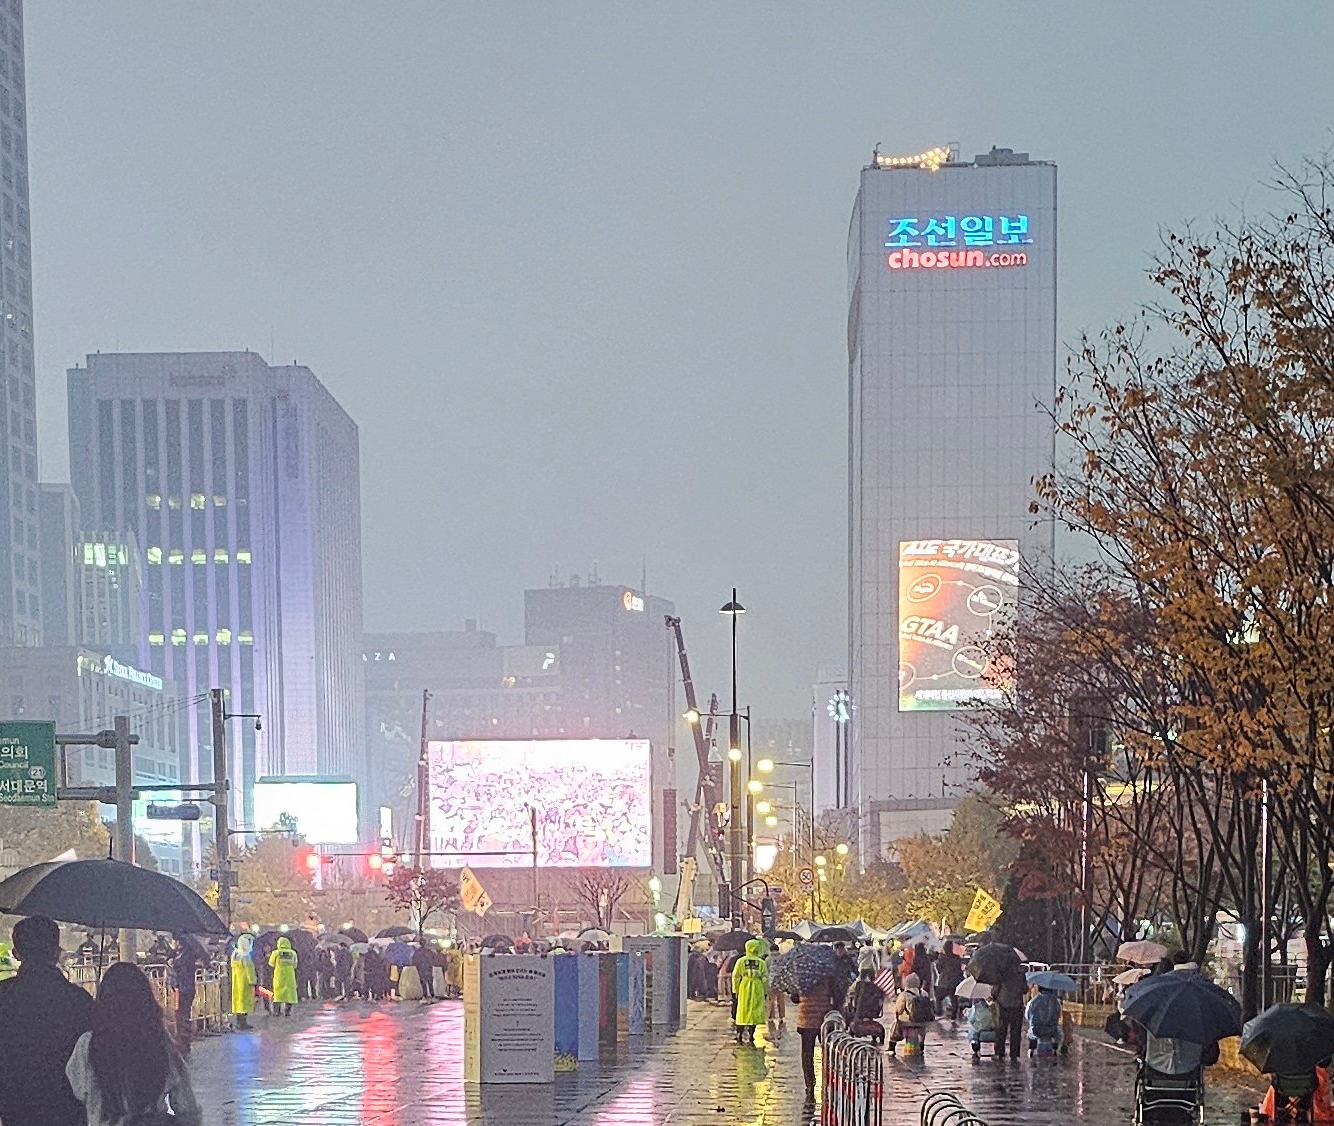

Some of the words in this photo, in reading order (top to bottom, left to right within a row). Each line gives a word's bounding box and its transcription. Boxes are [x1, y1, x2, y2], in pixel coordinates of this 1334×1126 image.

[884, 214, 1034, 247] 조선일보
[888, 248, 1027, 269] chosun.com
[902, 615, 959, 645] GTAA
[32, 768, 43, 777] 21
